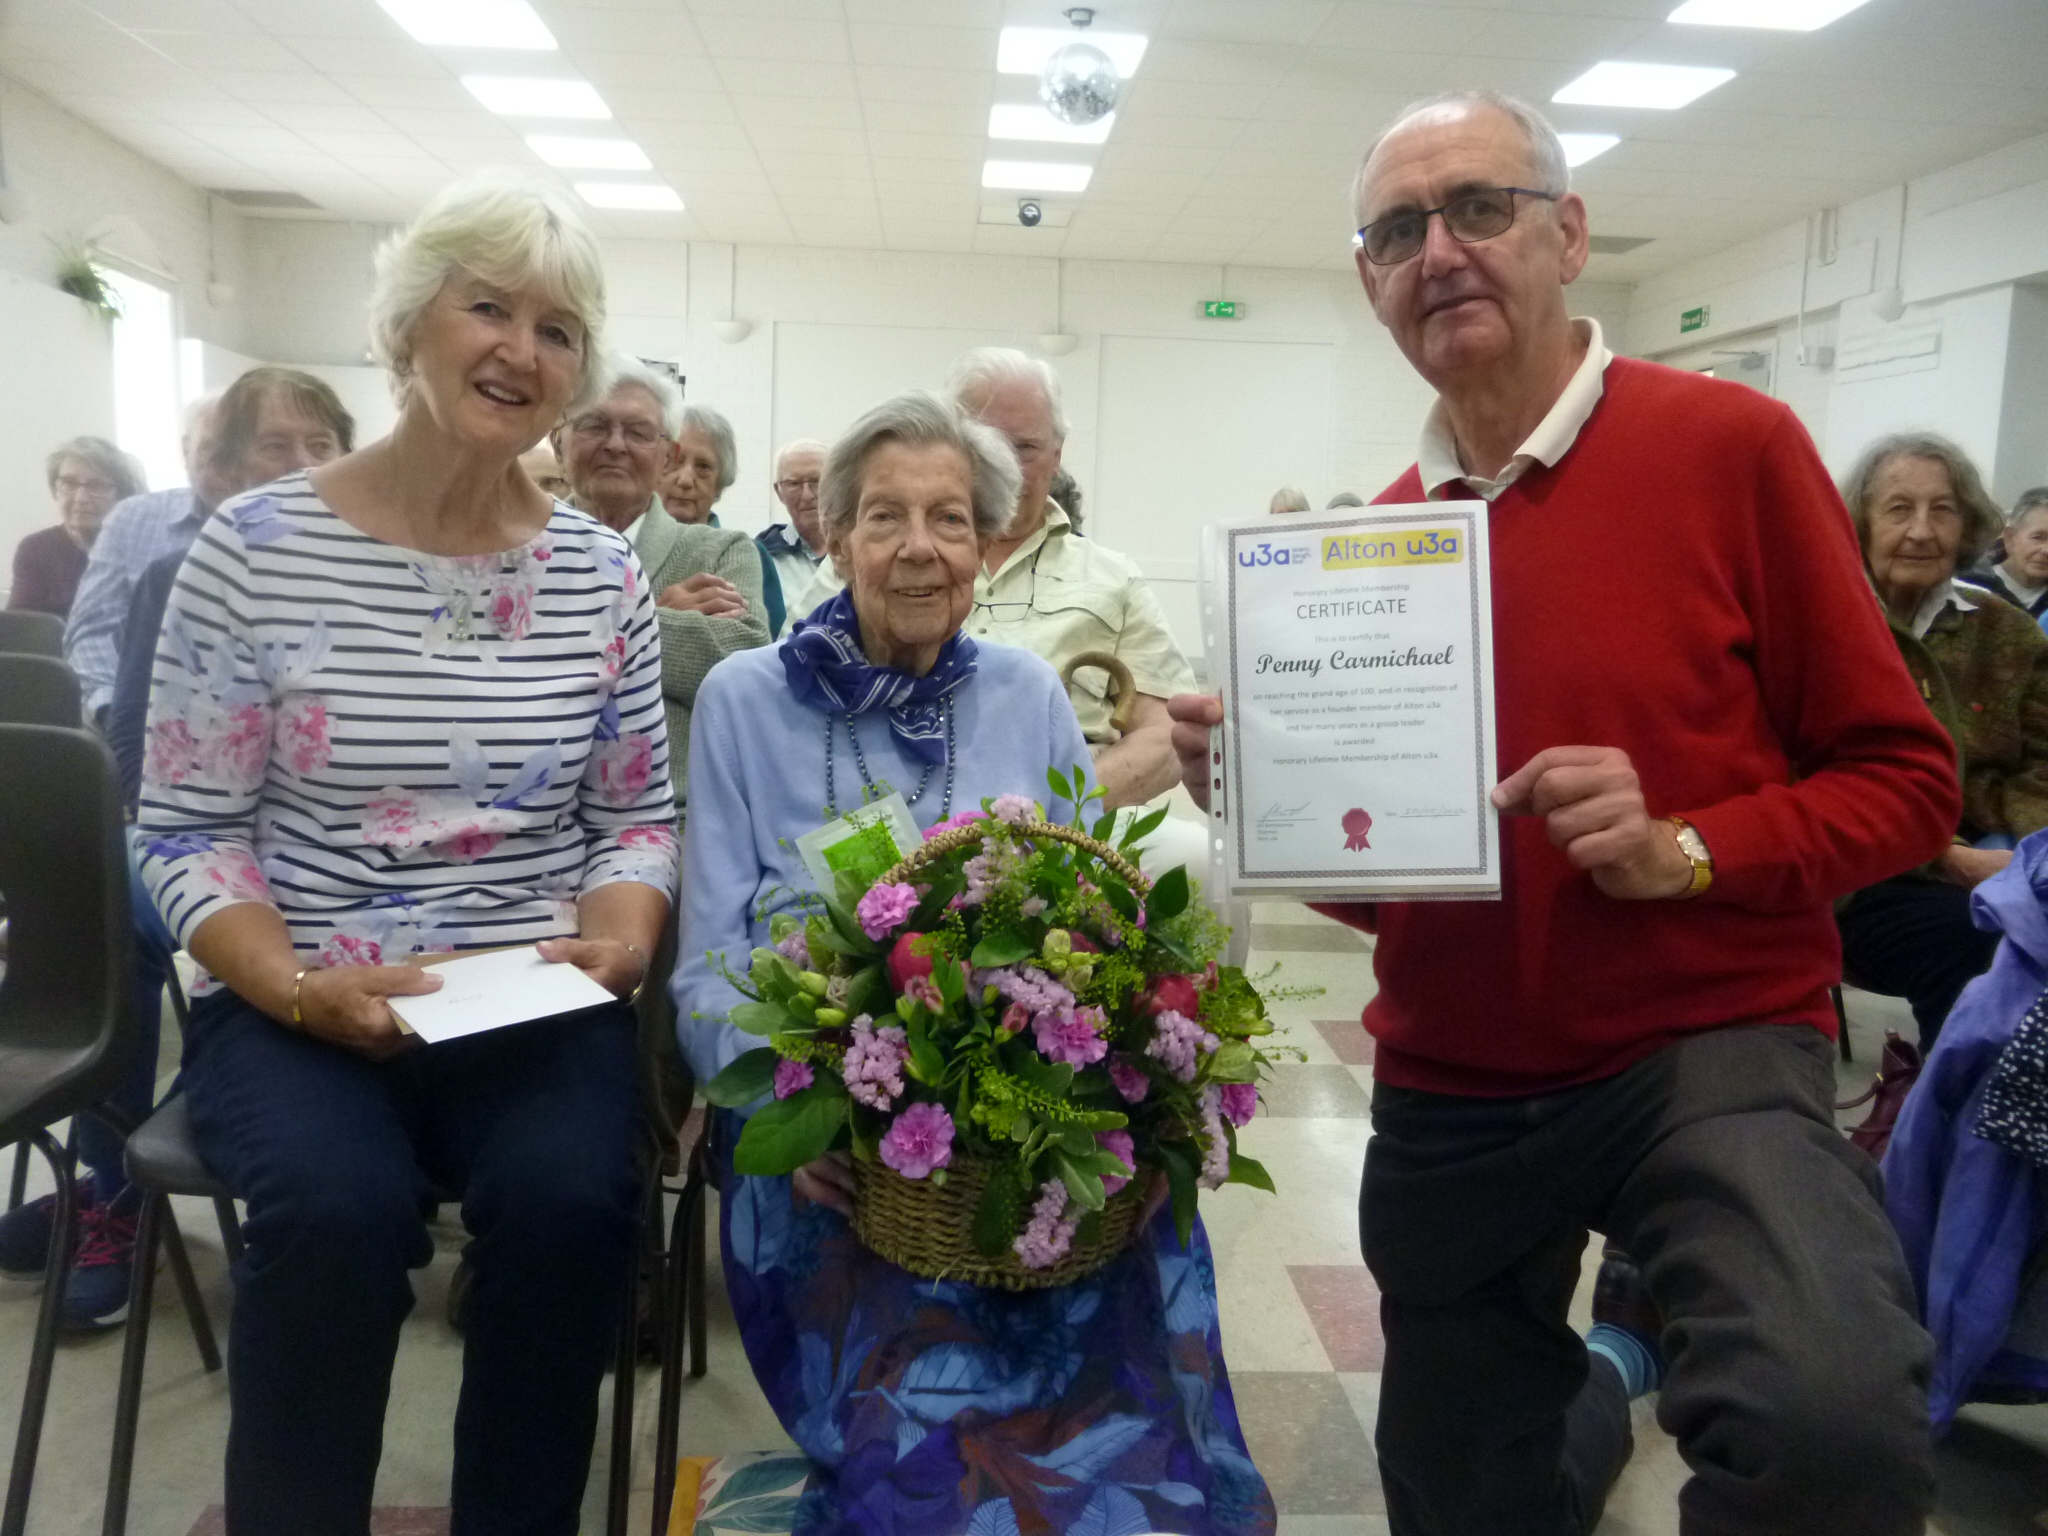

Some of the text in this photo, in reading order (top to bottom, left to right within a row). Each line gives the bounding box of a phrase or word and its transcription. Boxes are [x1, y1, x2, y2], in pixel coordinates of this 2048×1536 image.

[1326, 532, 1457, 562] Alton u3a
[1239, 543, 1290, 567] u3a
[1330, 587, 1359, 595] Lifetime
[1362, 584, 1410, 593] Membership
[1296, 598, 1407, 619] CERTIFICATE
[1348, 633, 1373, 641] certify
[1255, 644, 1454, 678] Penny Carmichael
[1264, 691, 1296, 700] reaching
[1312, 690, 1333, 699] grand
[1404, 684, 1448, 694] recognition
[1376, 721, 1399, 729] group
[1342, 738, 1376, 746] awarded
[1272, 758, 1307, 766] Honorary
[1309, 756, 1339, 764] Lifetime
[1342, 754, 1389, 762] Membership
[1390, 752, 1399, 760] of
[1424, 752, 1438, 760] u3a
